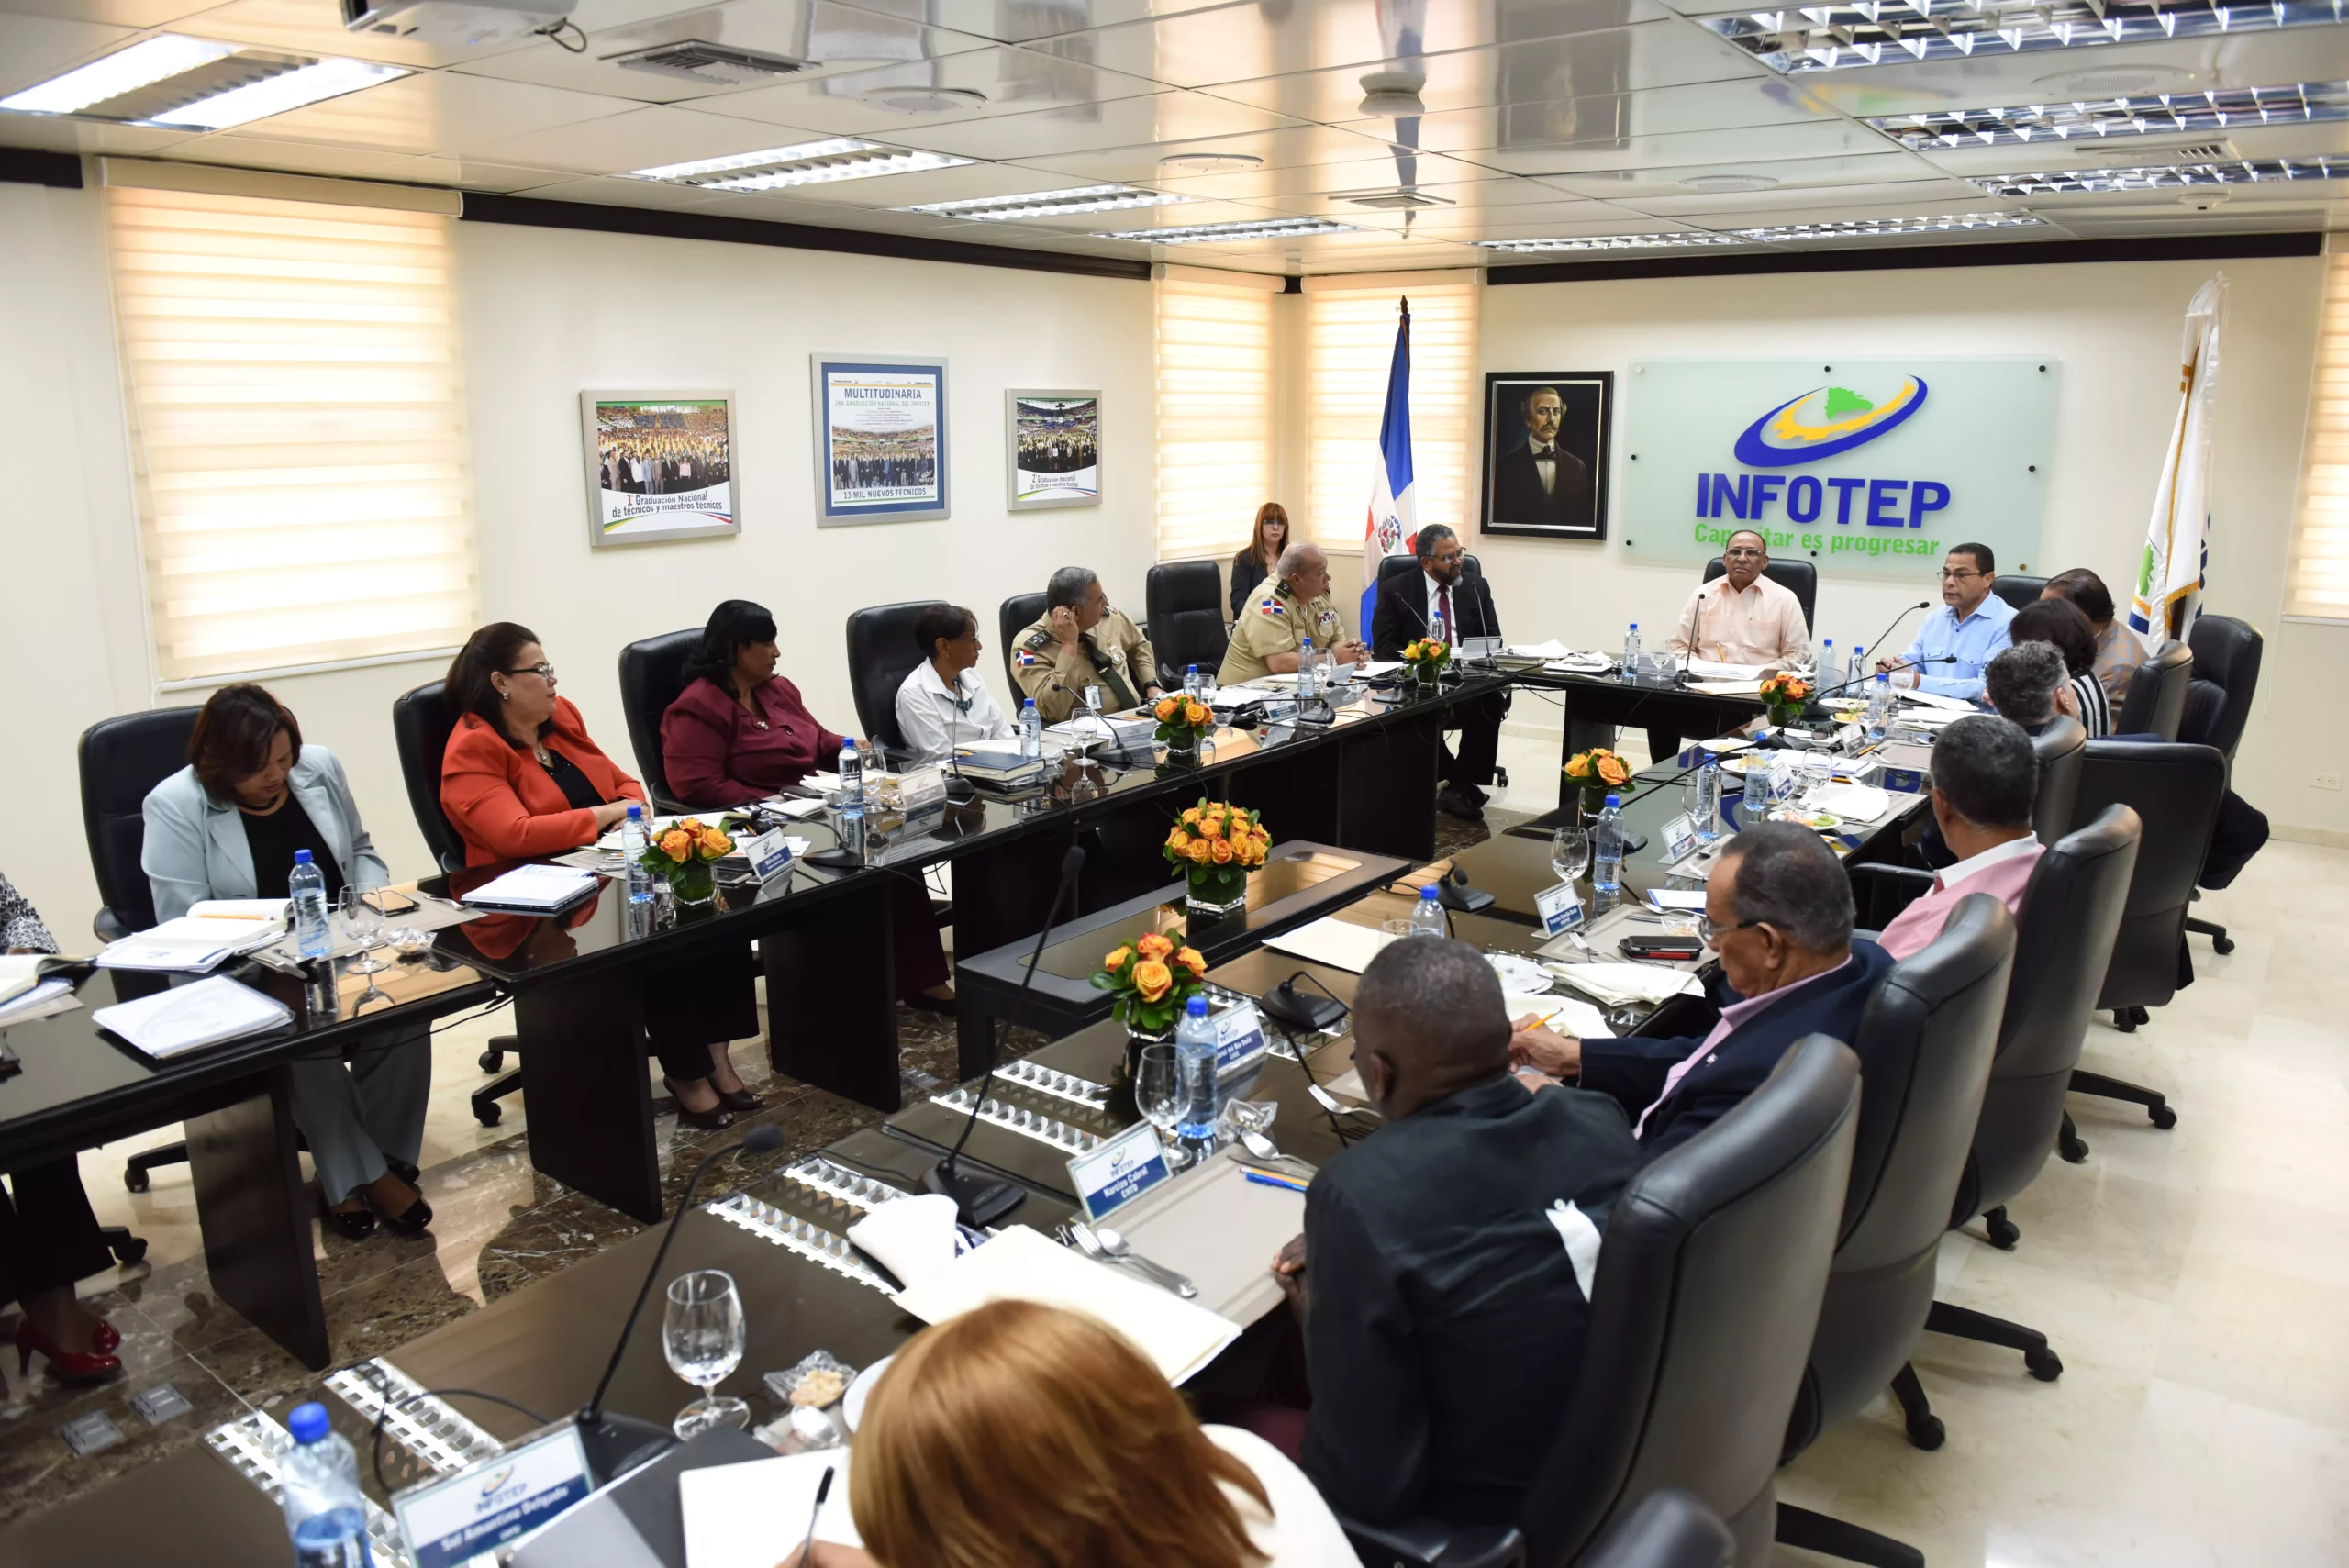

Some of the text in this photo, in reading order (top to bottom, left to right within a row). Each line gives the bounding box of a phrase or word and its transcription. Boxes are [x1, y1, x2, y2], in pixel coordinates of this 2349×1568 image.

[844, 388, 921, 399] MULTITUDINARIA
[635, 495, 676, 506] Graduación
[678, 490, 708, 504] Nacional
[843, 491, 852, 499] 13
[853, 490, 865, 498] MIL
[868, 489, 894, 497] NUEVOS
[1696, 473, 1951, 528] INFOTEP
[612, 506, 622, 517] de
[662, 502, 695, 511] maestros
[1695, 523, 1940, 557] Capitar es progresar
[1127, 1165, 1149, 1184] Cabral
[475, 1483, 529, 1513] INFOTEP
[520, 1485, 570, 1515] Delgado
